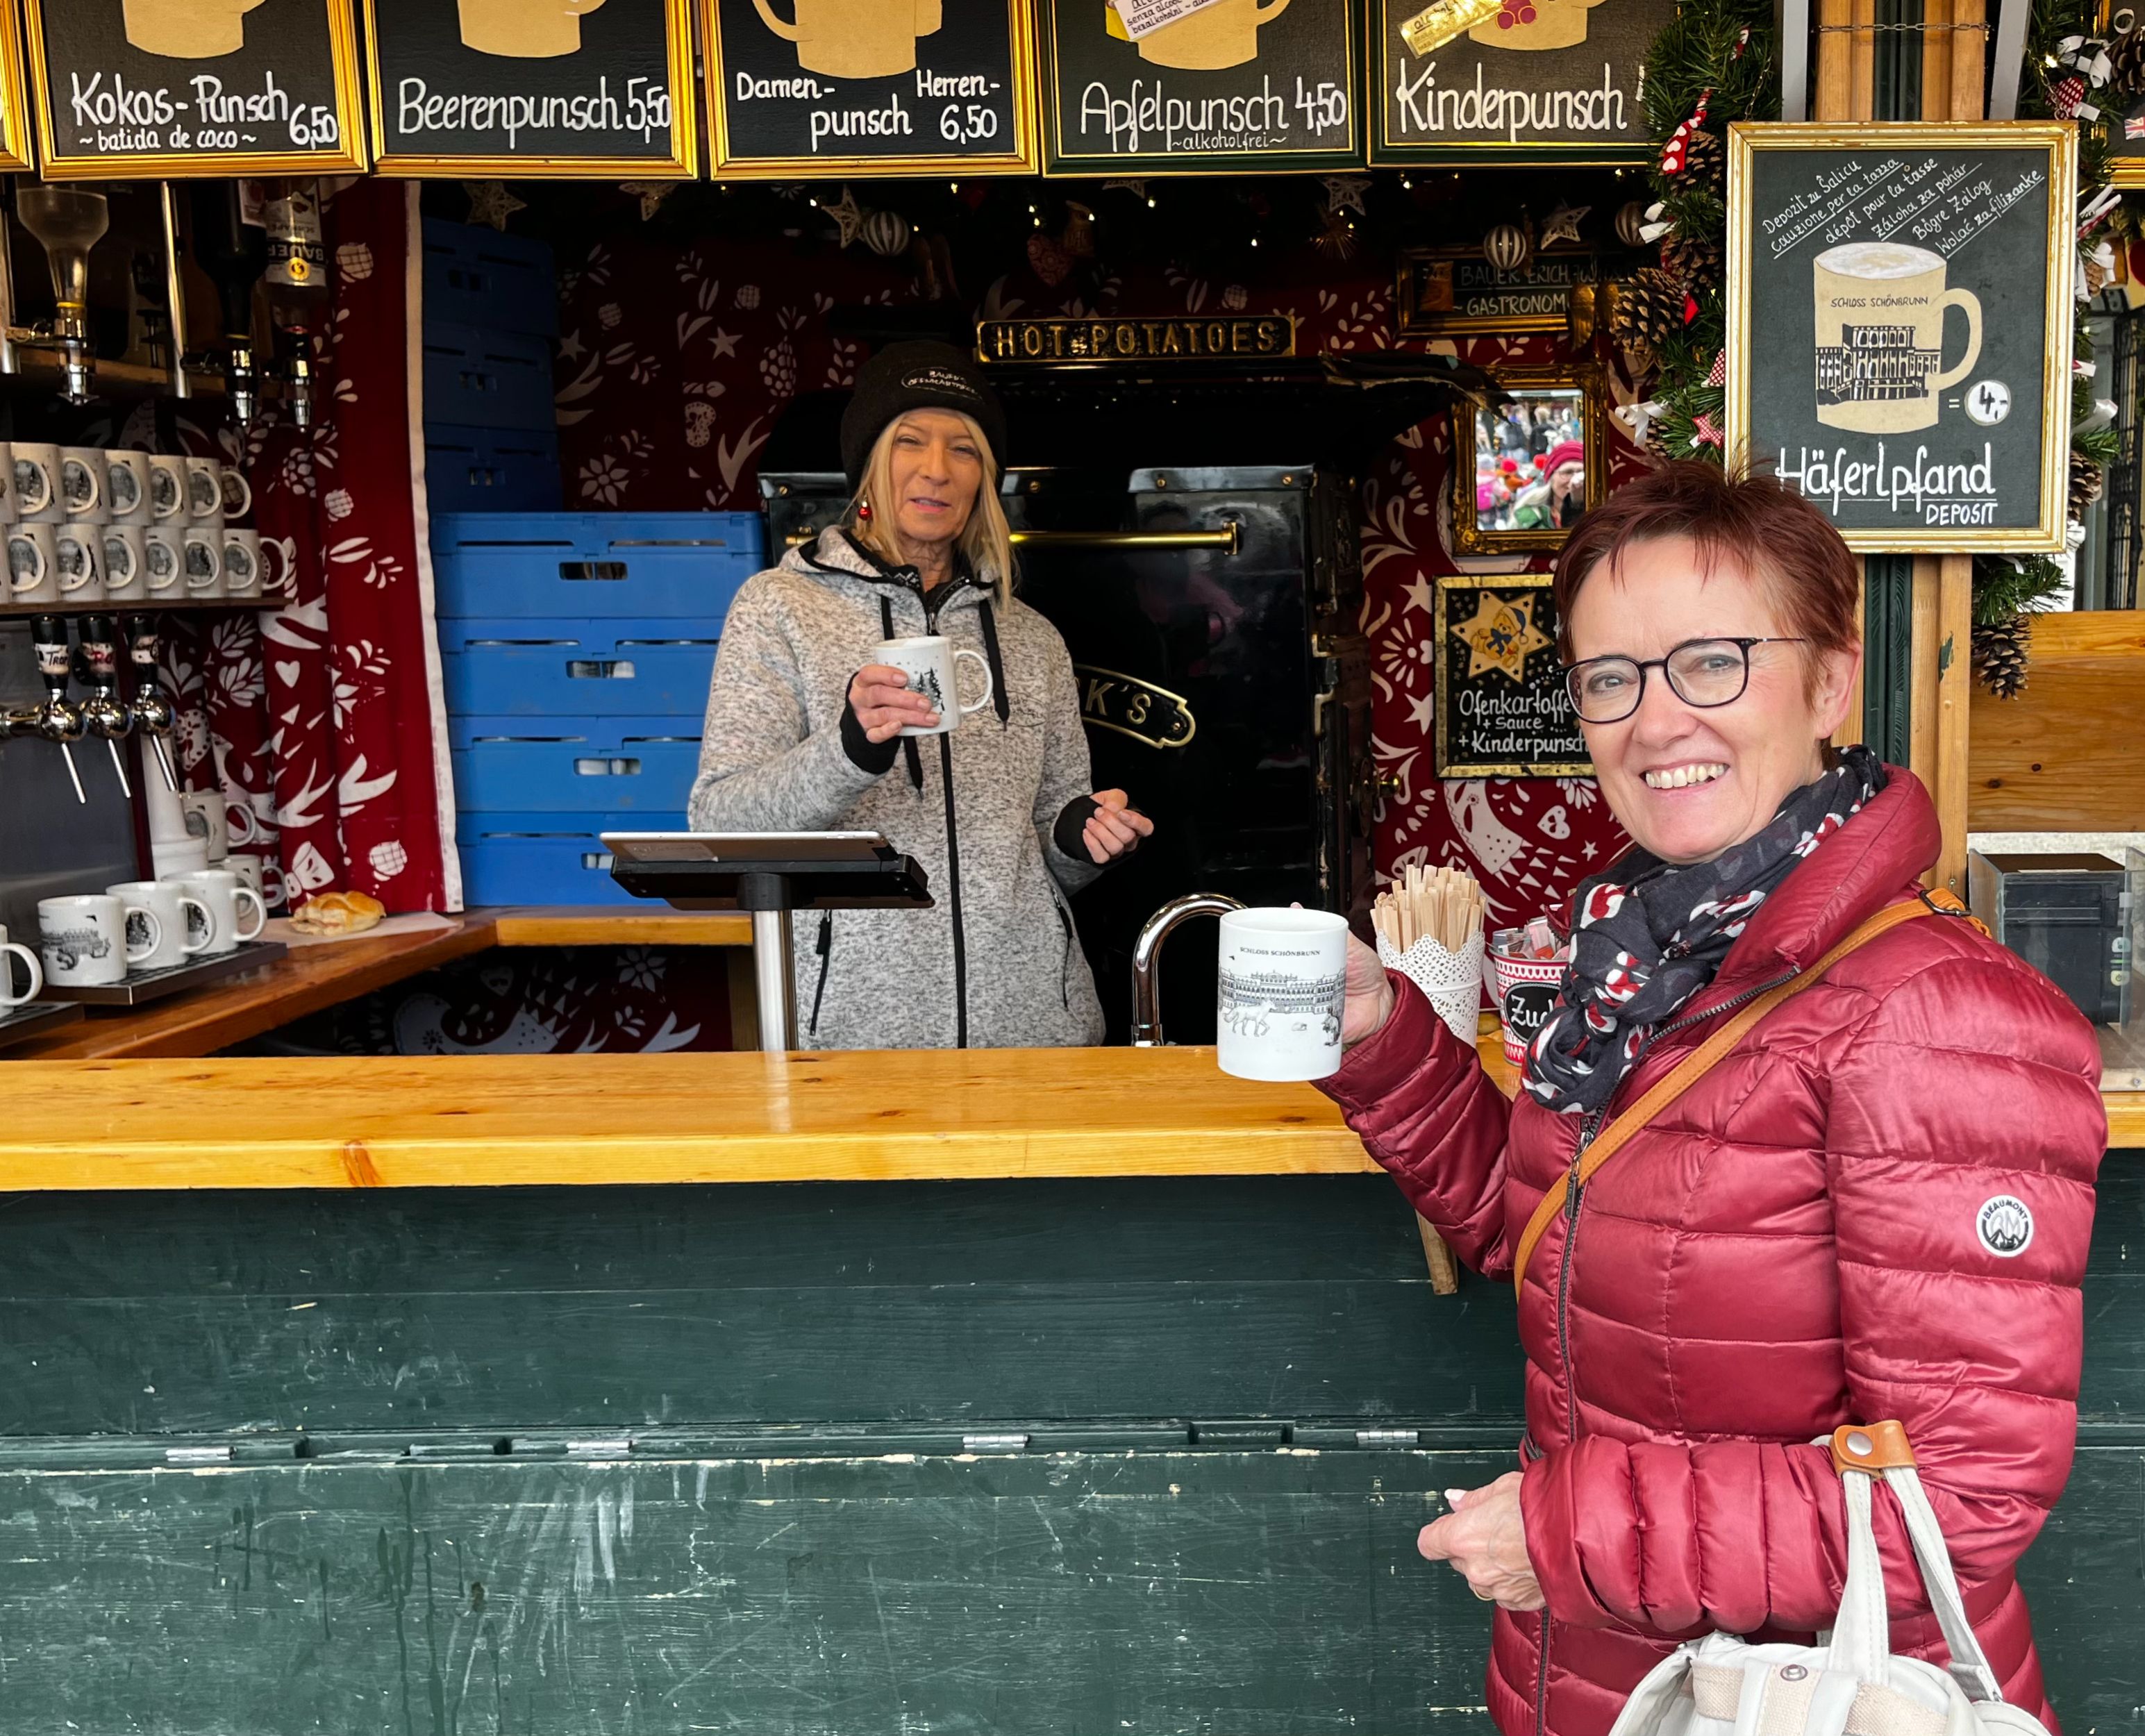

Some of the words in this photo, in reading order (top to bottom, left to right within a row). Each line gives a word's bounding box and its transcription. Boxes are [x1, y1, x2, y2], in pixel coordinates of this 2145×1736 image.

[736, 72, 835, 101] Damen-
[916, 69, 1001, 97] Herren-
[1396, 58, 1628, 143] Kinderpunsch
[289, 104, 339, 150] 6,50
[399, 76, 624, 149] Beerenpunsch
[626, 76, 671, 144] 5,50
[810, 94, 913, 152] punsch
[940, 104, 998, 144] 6,50
[1080, 74, 1289, 152] Apfelpunsch
[1294, 76, 1347, 137] 4,50
[169, 131, 191, 149] de
[1771, 209, 1827, 253] cauzione
[1826, 193, 1845, 217] per
[1846, 183, 1864, 197] la
[1862, 158, 1900, 185] tazza
[1862, 193, 1887, 220] pour
[1887, 183, 1905, 198] la
[1902, 158, 1938, 185] tasse
[1917, 188, 1936, 206] za
[1973, 210, 1993, 226] za
[1988, 169, 2042, 219] filizanke
[1830, 297, 1867, 308] SCHLOSS
[1870, 294, 1928, 307] SCHÖNBRUNN
[996, 325, 1067, 358] HOT
[1090, 322, 1276, 356] POTATOES
[1775, 442, 1996, 516] Häferlpfand
[1925, 502, 1998, 526] DEPOSIT
[1459, 687, 1572, 726] Ofenkartoffe
[1240, 946, 1269, 955] SCHLOSS
[1983, 1199, 2028, 1220] BEAUMONT
